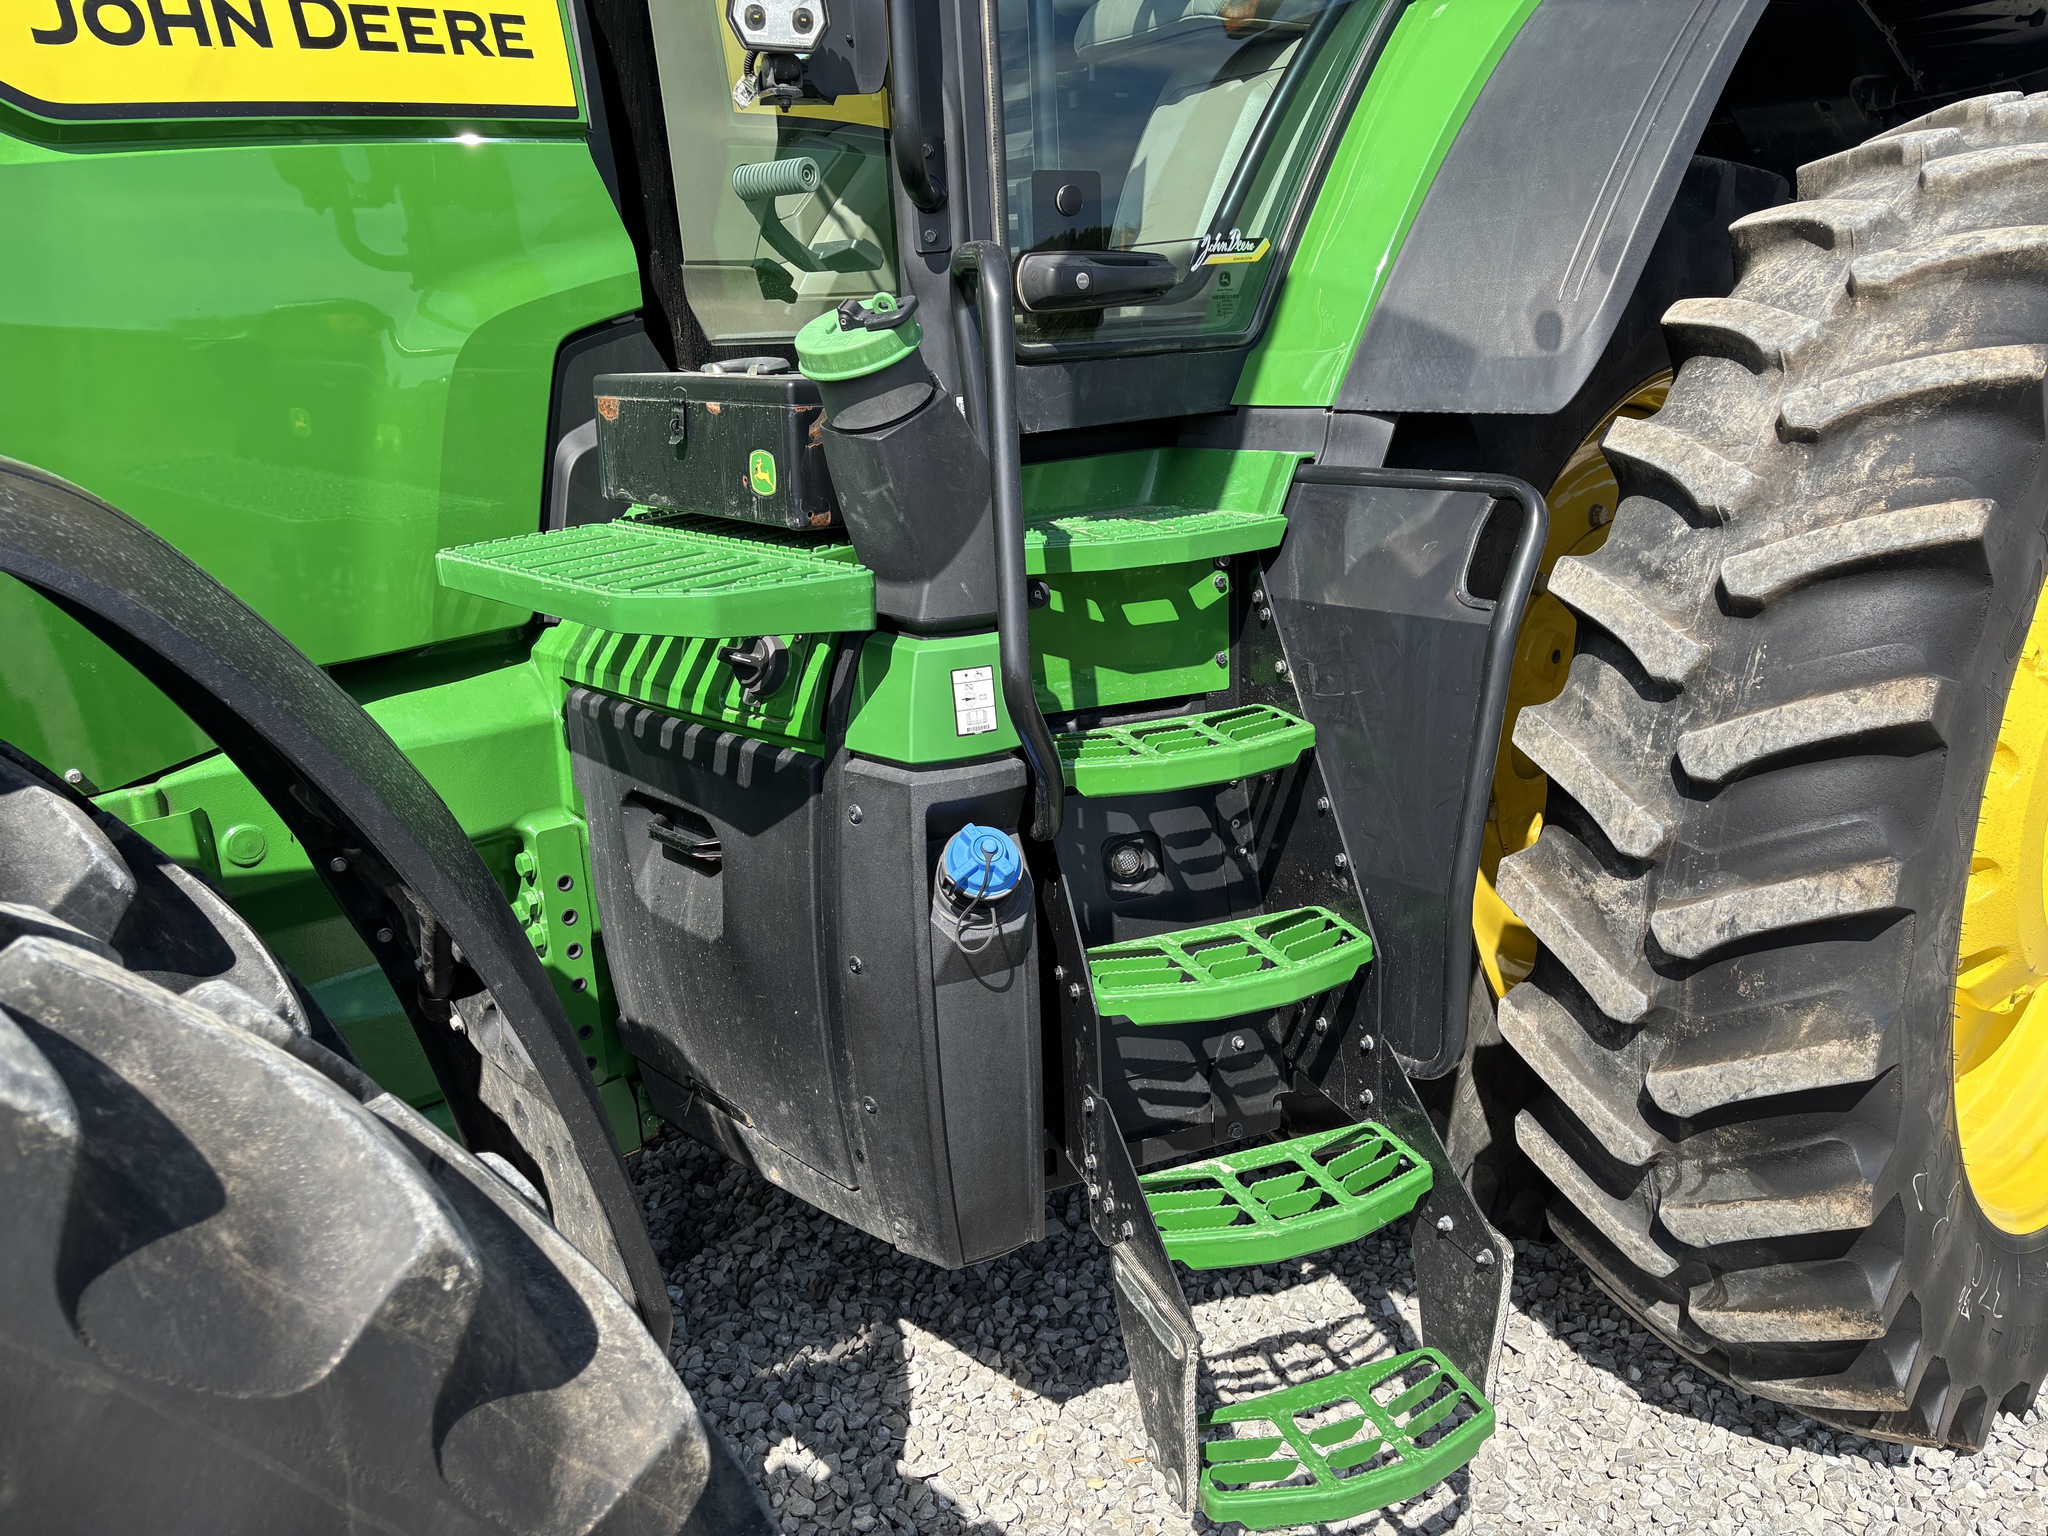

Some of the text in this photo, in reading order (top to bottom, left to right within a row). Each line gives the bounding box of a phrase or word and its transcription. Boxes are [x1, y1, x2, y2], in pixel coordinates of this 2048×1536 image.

[30, 0, 535, 59] JOHN DEERE
[1190, 227, 1255, 272] John Deere
